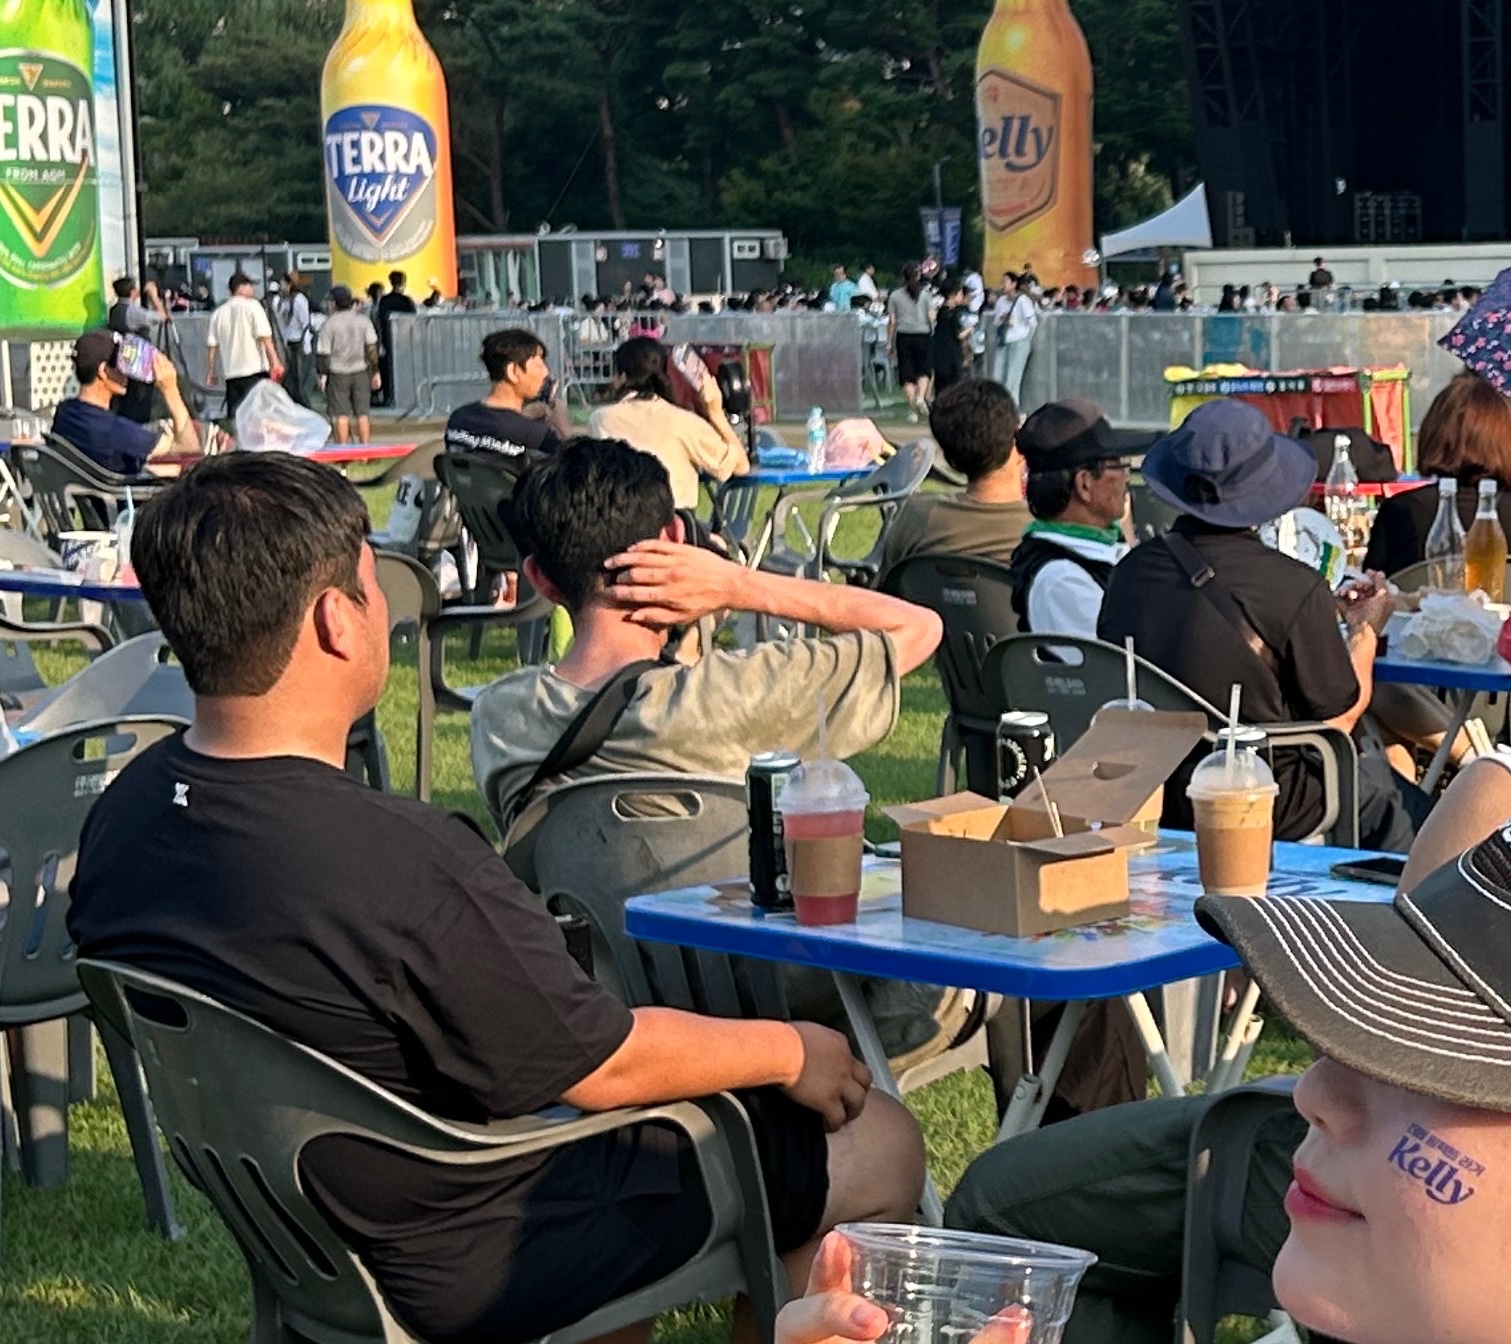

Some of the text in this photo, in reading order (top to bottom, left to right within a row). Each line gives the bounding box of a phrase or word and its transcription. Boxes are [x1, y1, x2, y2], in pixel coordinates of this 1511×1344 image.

[0, 93, 95, 167] ERRA
[326, 130, 434, 179] TERRA
[979, 114, 1054, 173] elly
[346, 173, 410, 213] Light
[1387, 1135, 1475, 1205] Kelly
